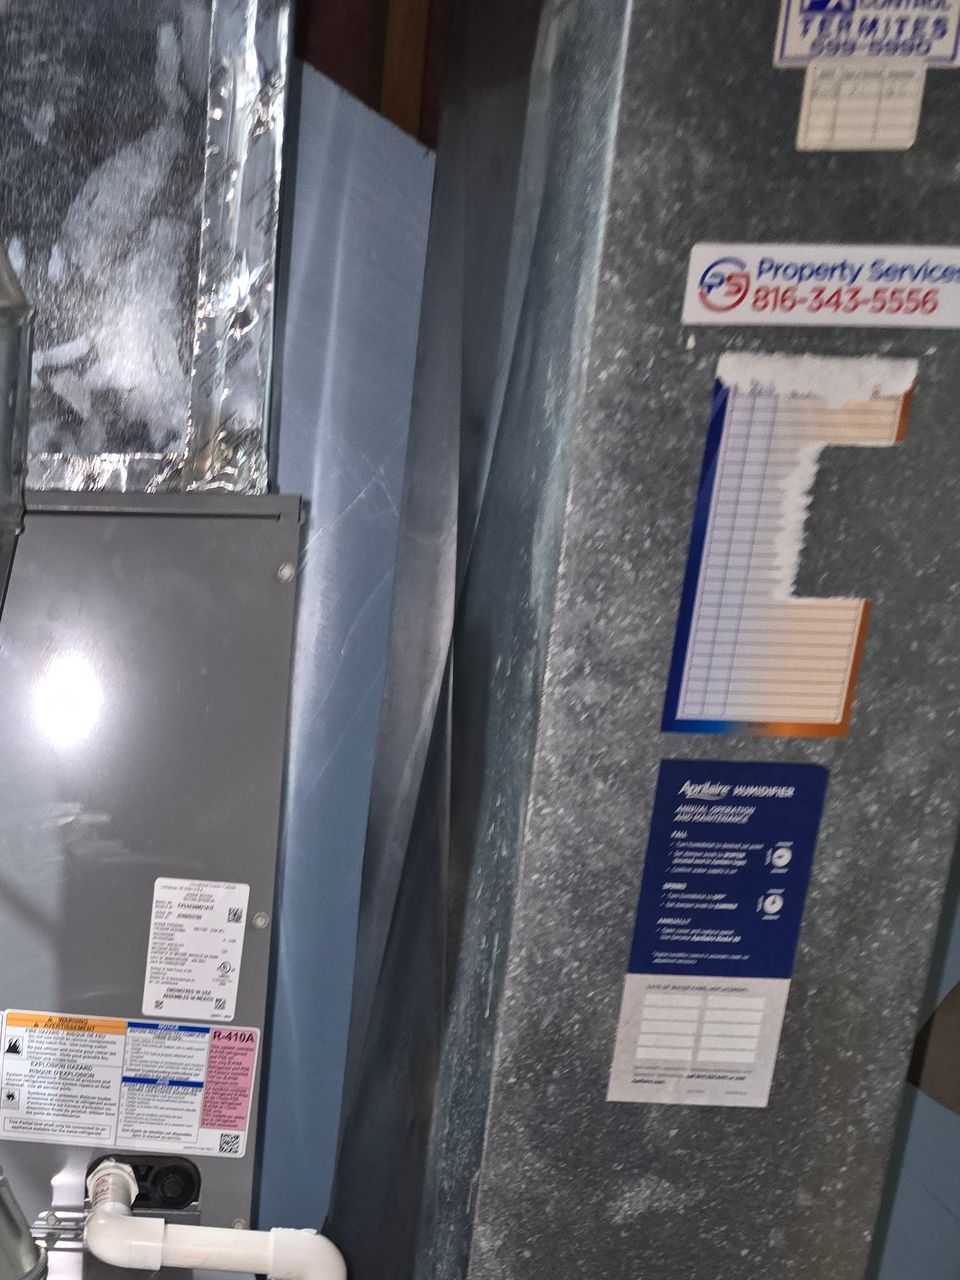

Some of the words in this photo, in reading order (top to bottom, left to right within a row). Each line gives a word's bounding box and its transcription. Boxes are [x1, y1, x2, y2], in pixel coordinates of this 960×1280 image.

[756, 257, 865, 285] Property
[750, 286, 939, 315] 816-343-5556
[213, 1030, 255, 1043] R-410A
